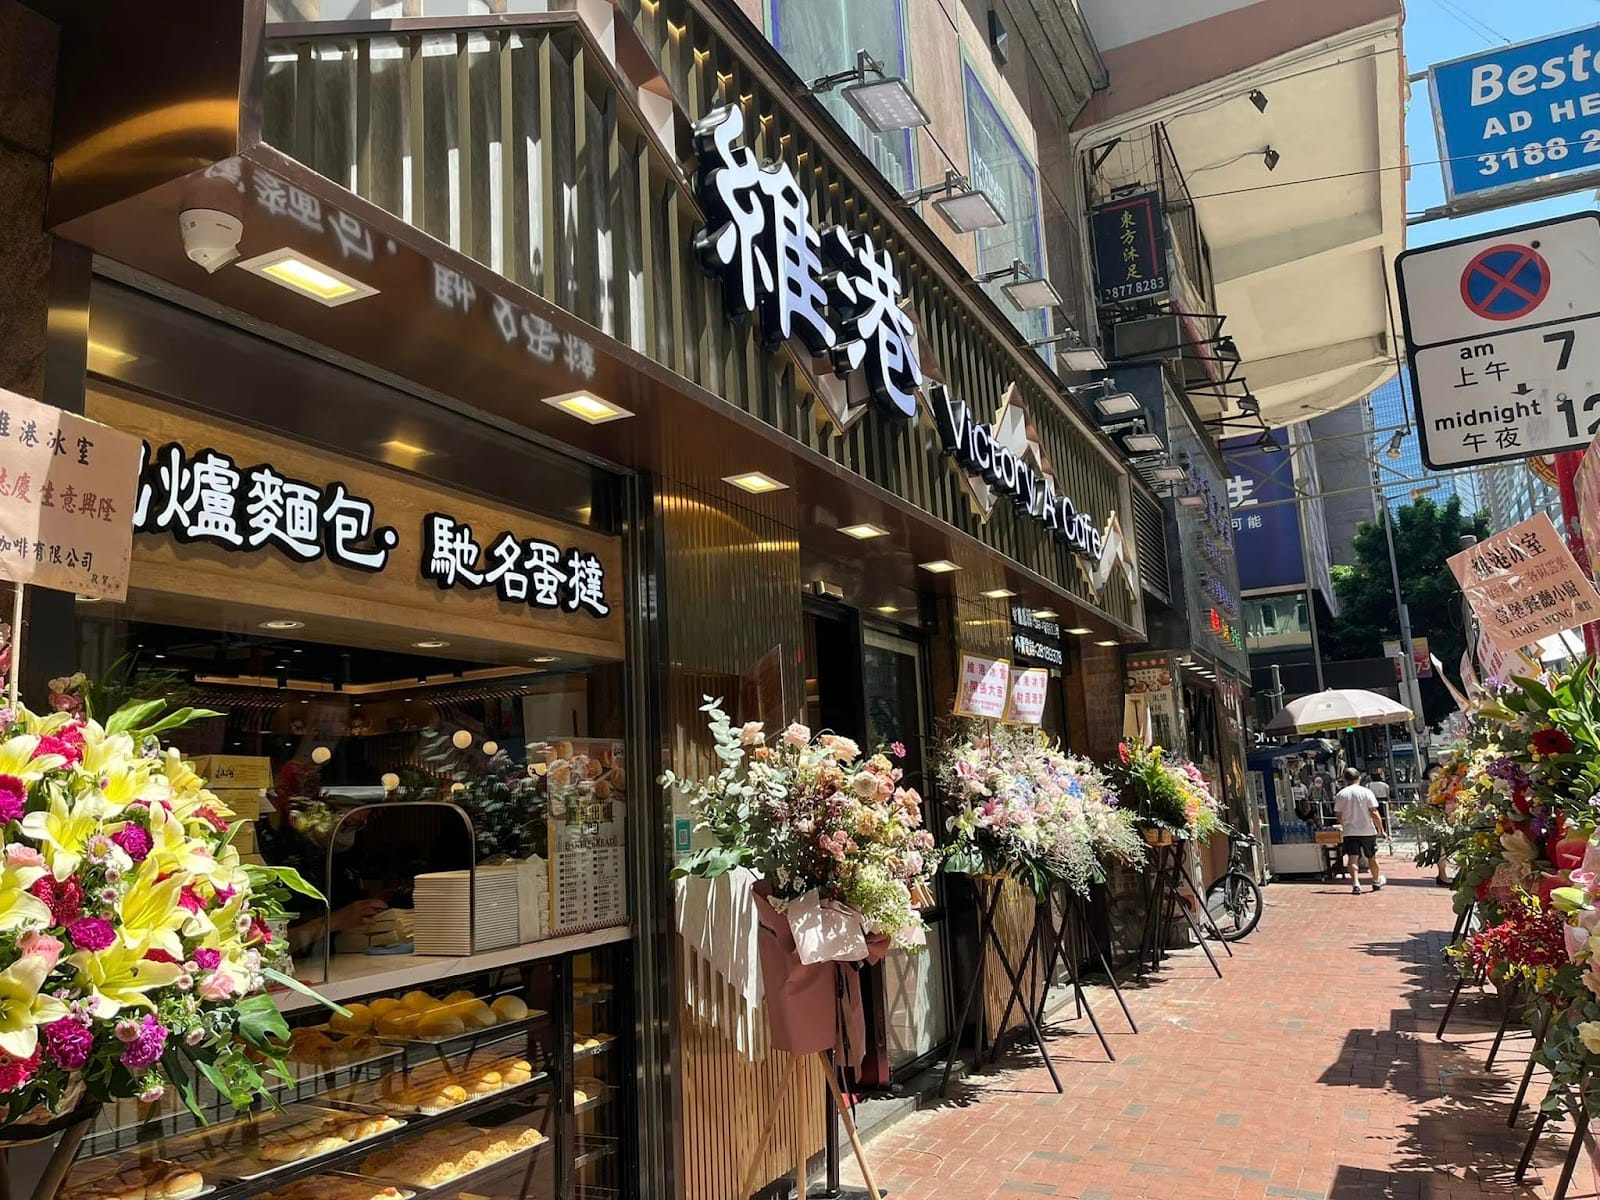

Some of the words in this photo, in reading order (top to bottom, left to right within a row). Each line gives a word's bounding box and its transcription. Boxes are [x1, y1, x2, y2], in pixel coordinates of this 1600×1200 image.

[1471, 44, 1600, 107] Best
[1482, 111, 1533, 140] AD
[1477, 137, 1569, 176] 3188
[710, 103, 924, 418] 雅港
[1120, 210, 1143, 281] 東方沐足
[1135, 277, 1165, 293] 8283
[1460, 343, 1494, 360] am
[1543, 330, 1576, 371] 7
[1453, 361, 1510, 388] 上午
[1435, 399, 1542, 431] midnight
[1462, 427, 1522, 453] 午夜
[942, 383, 1035, 515] Victory
[1043, 479, 1058, 529] A
[1063, 497, 1102, 560] Cafe
[1231, 514, 1263, 531] 可能
[427, 514, 610, 616] 馳名蛋撻
[1509, 621, 1540, 640] JAMES
[1541, 608, 1573, 626] WONG
